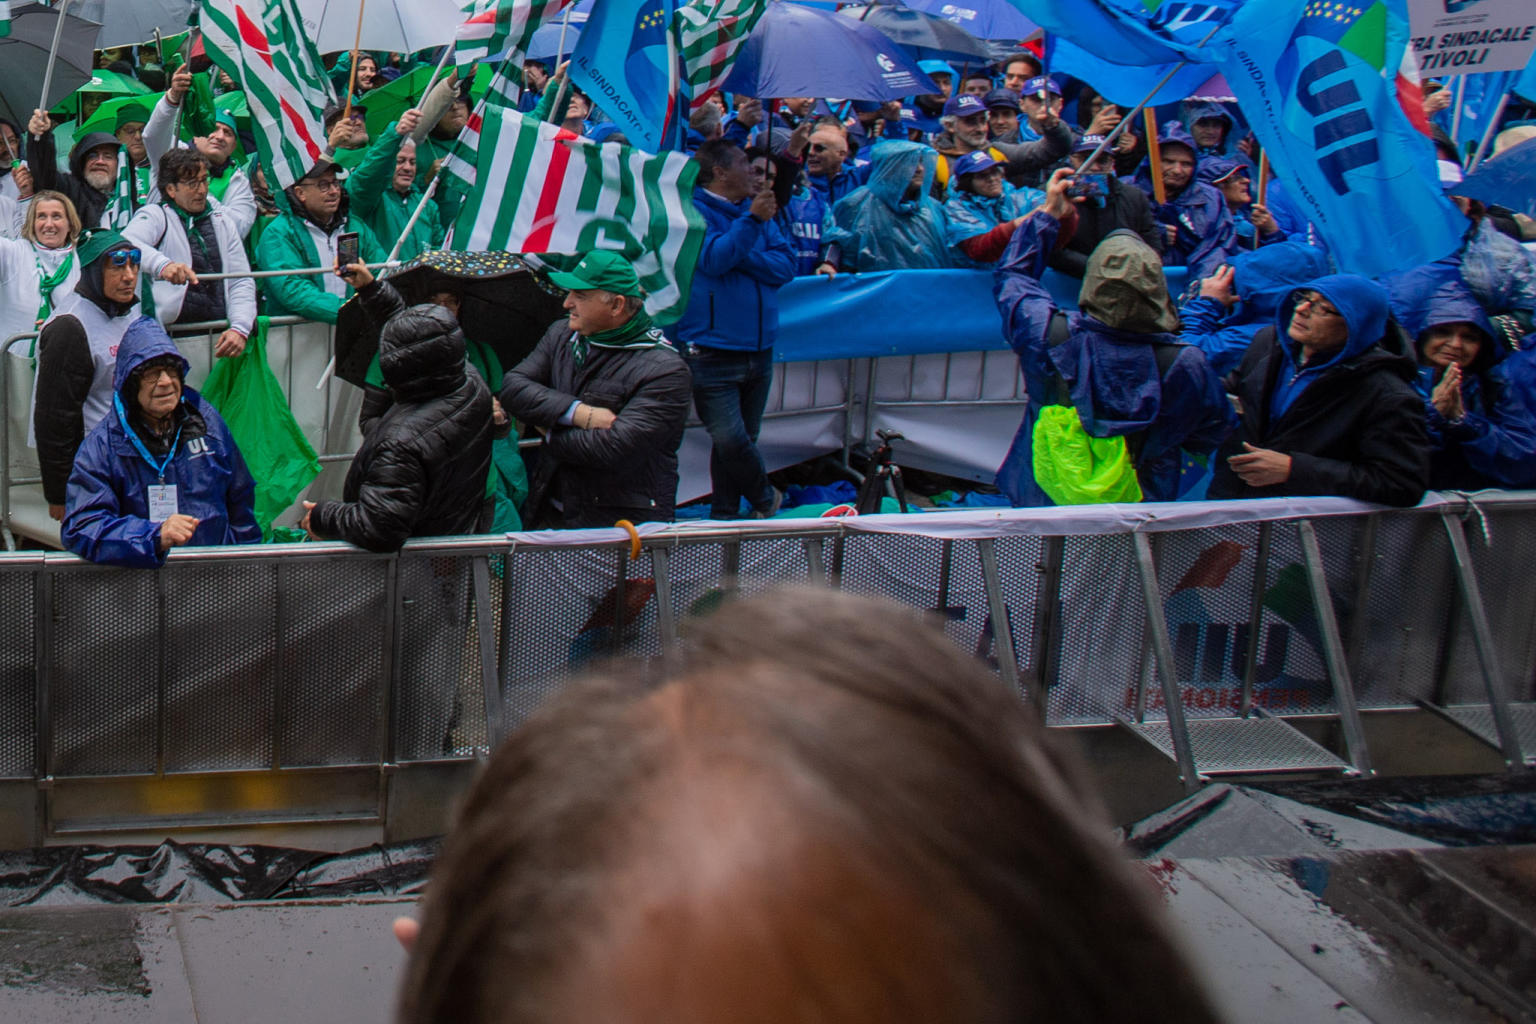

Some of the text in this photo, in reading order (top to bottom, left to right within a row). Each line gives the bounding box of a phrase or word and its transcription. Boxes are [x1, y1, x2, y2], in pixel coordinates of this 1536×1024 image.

[1437, 25, 1536, 49] SINDACALE
[1420, 48, 1490, 71] TIVOLI
[1297, 42, 1380, 197] UIL
